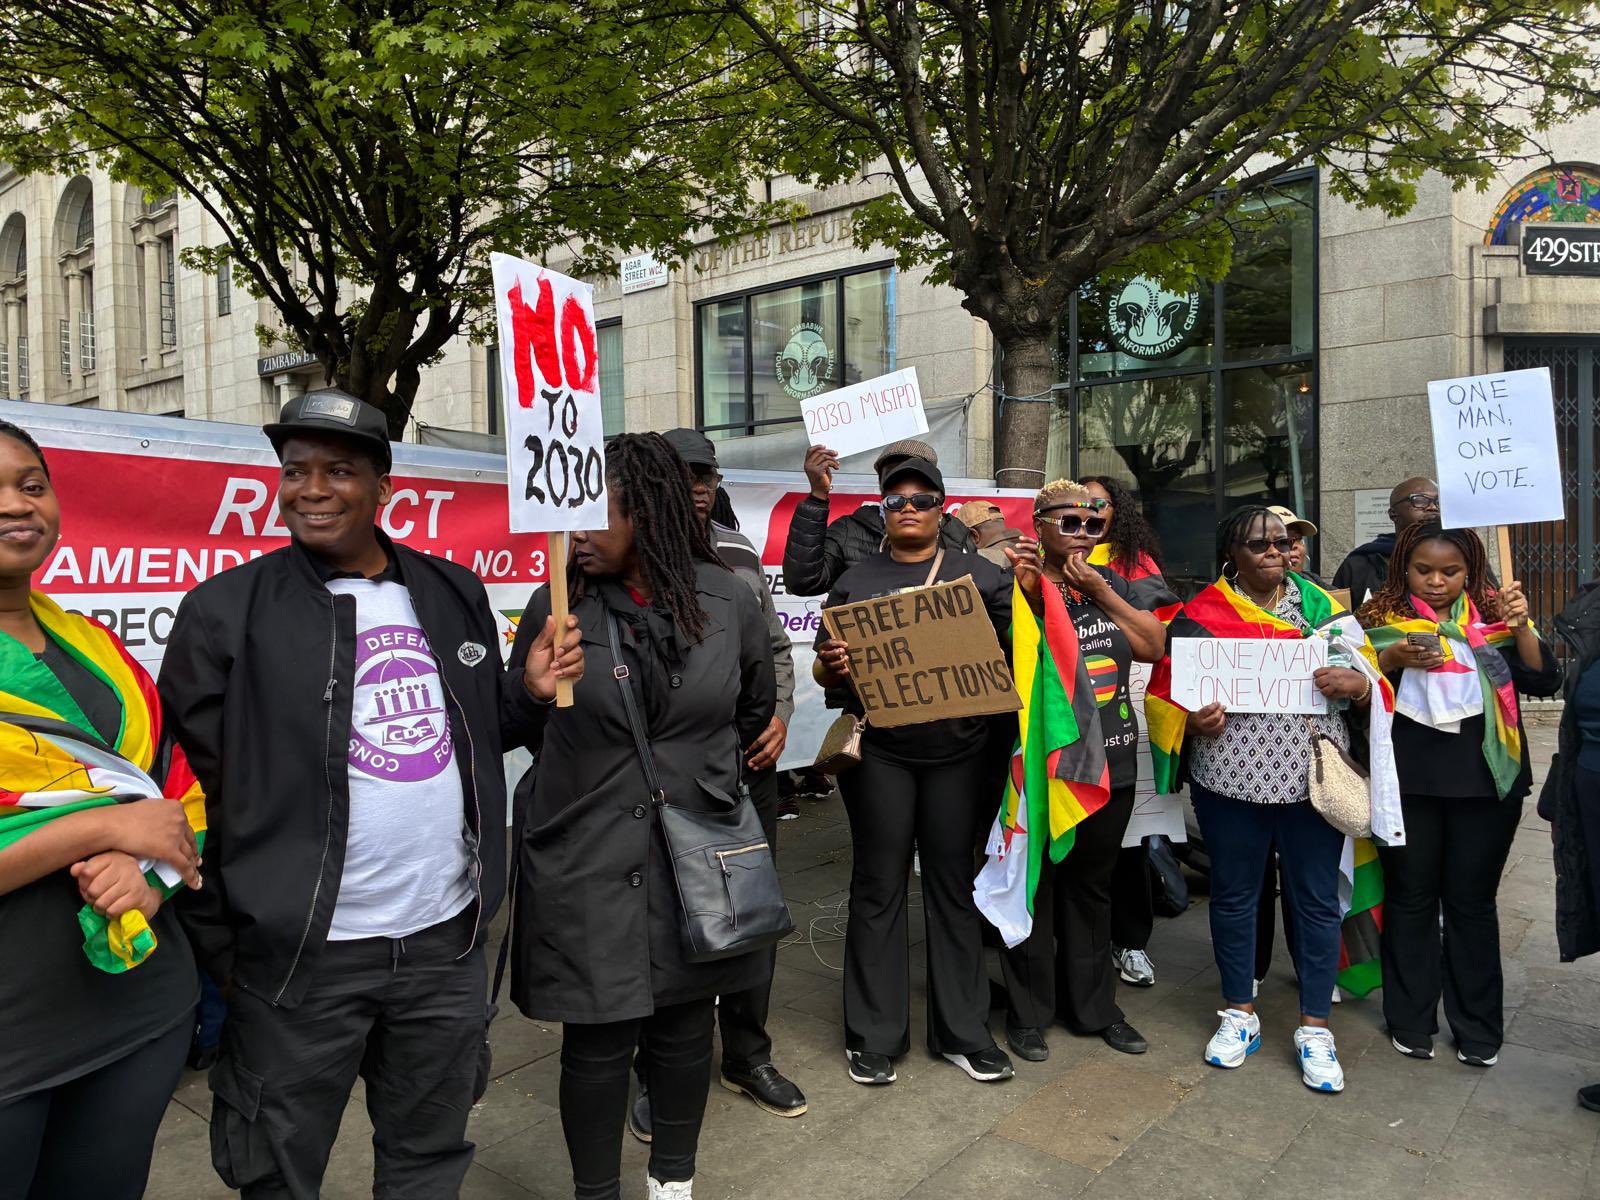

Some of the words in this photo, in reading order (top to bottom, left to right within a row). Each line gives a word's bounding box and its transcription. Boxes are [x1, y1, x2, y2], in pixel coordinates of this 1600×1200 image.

[624, 259, 642, 272] AGAR
[700, 251, 722, 273] OF
[732, 234, 770, 266] THE
[624, 268, 647, 282] STREET
[648, 265, 663, 276] WC2
[507, 269, 598, 409] NO
[790, 322, 824, 336] ZIMBABWE
[1108, 294, 1122, 336] TOURIST
[1118, 332, 1184, 356] INFORMATION
[1183, 291, 1199, 331] CENTRE
[775, 351, 785, 384] TOURIST
[783, 380, 826, 400] INFORMATION
[1447, 379, 1509, 406] ONE
[540, 388, 578, 440] TO
[804, 401, 852, 435] 2030
[1458, 437, 1512, 459] ONE
[524, 433, 604, 508] 2030
[1464, 466, 1534, 496] VOTE.
[471, 550, 517, 577] NO.
[528, 550, 545, 576] 3
[832, 597, 910, 642] FREE
[914, 584, 974, 624] AND
[849, 636, 915, 679] FAIR
[1080, 638, 1112, 651] calling
[1199, 640, 1254, 670] ONE
[1259, 642, 1325, 673] MAN
[858, 659, 1012, 711] ELECTIONS
[1199, 675, 1253, 707] ONE
[1257, 676, 1322, 709] VOTE
[389, 725, 431, 742] CDF
